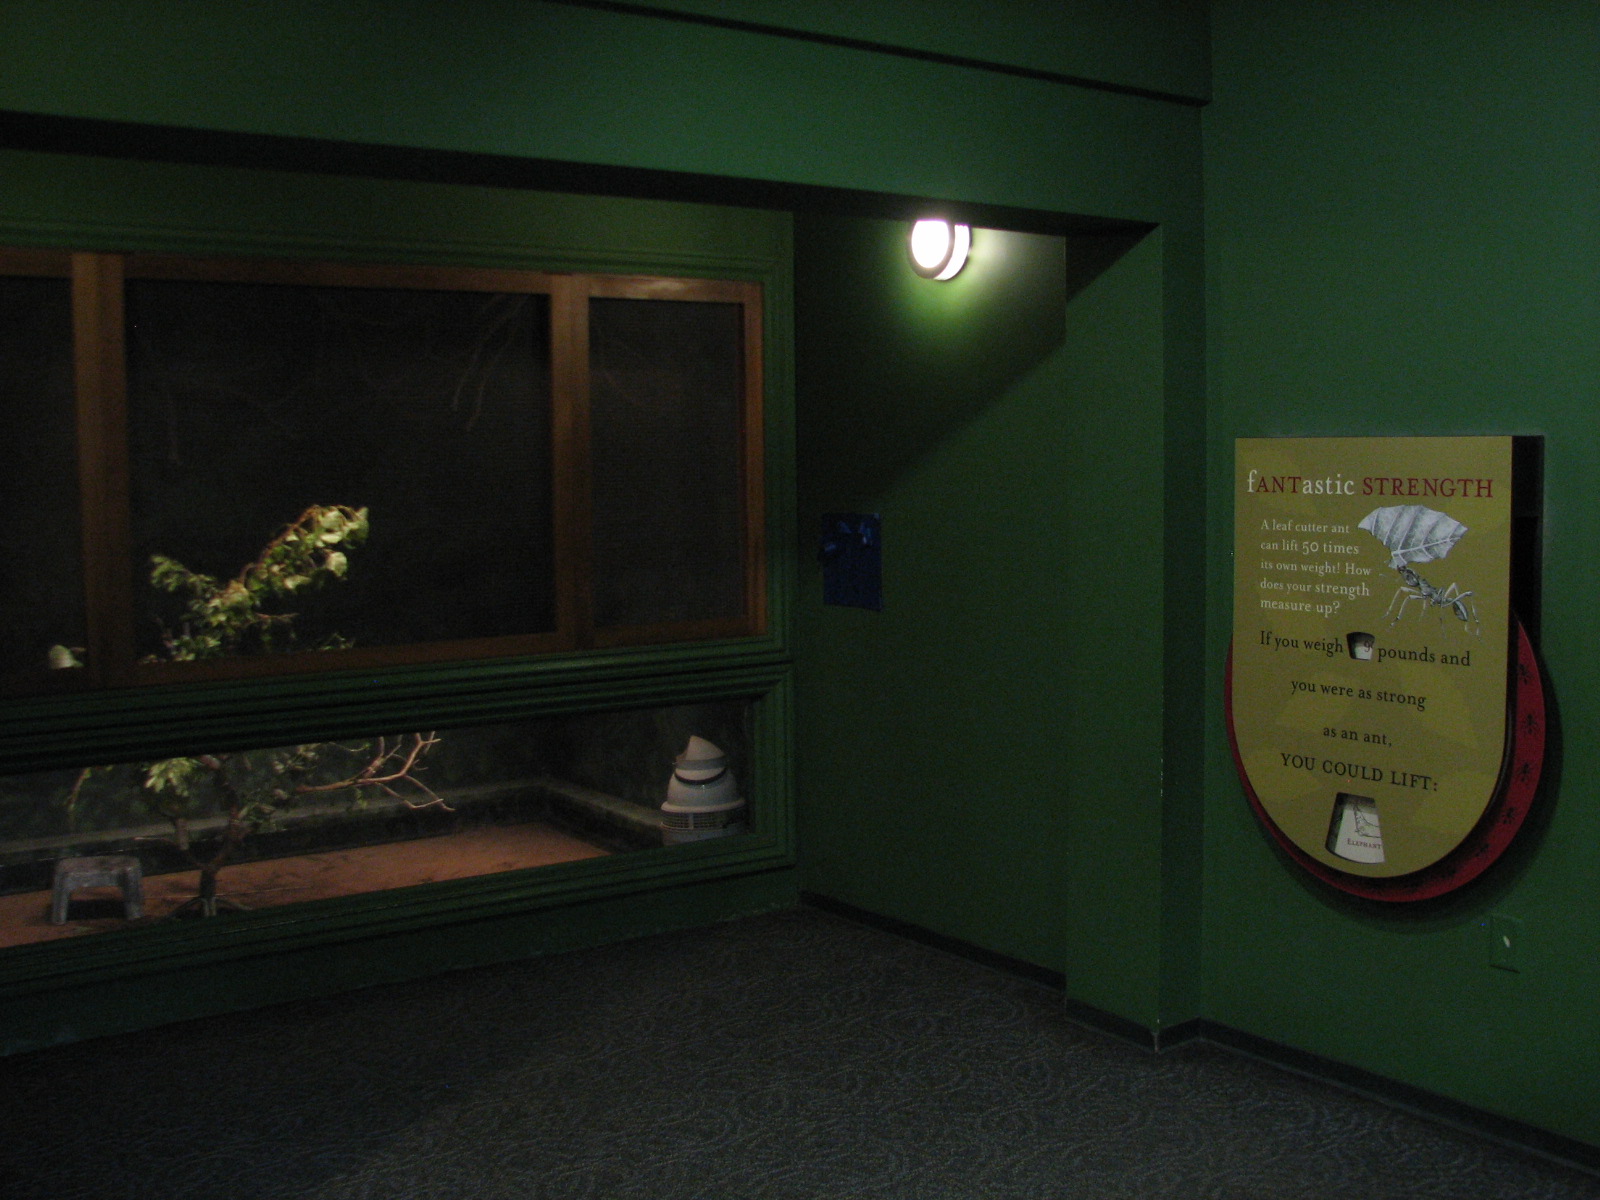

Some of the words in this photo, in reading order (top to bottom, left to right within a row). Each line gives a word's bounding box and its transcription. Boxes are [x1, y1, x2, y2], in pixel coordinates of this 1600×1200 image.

[1247, 470, 1354, 495] fANTastic
[1363, 477, 1493, 497] STRENGTH
[1261, 521, 1269, 530] A
[1272, 520, 1292, 531] leaf
[1295, 522, 1328, 533] cutter
[1331, 524, 1349, 533] ant
[1261, 542, 1278, 551] can
[1282, 539, 1299, 551] lift
[1302, 542, 1319, 555] 50
[1323, 543, 1359, 554] times
[1261, 560, 1273, 570] its
[1276, 562, 1297, 571] own
[1301, 562, 1340, 577] weight!
[1345, 563, 1371, 575] How
[1260, 579, 1284, 590] does
[1286, 582, 1311, 594] your
[1315, 582, 1370, 599] strength
[1260, 600, 1311, 612] measure
[1316, 602, 1340, 618] up?
[1260, 631, 1271, 646] If
[1274, 636, 1299, 651] you
[1303, 637, 1343, 655] weigh
[1378, 646, 1435, 663] pounds
[1441, 651, 1470, 666] and
[1291, 680, 1316, 694] you
[1320, 684, 1353, 697] were
[1359, 690, 1372, 699] as
[1377, 690, 1426, 711] strong
[1323, 727, 1337, 736] as
[1341, 729, 1358, 740] an
[1363, 732, 1392, 747] ant,
[1281, 753, 1315, 770] YOU
[1323, 760, 1383, 781] COULD
[1391, 770, 1438, 792] LIFT:
